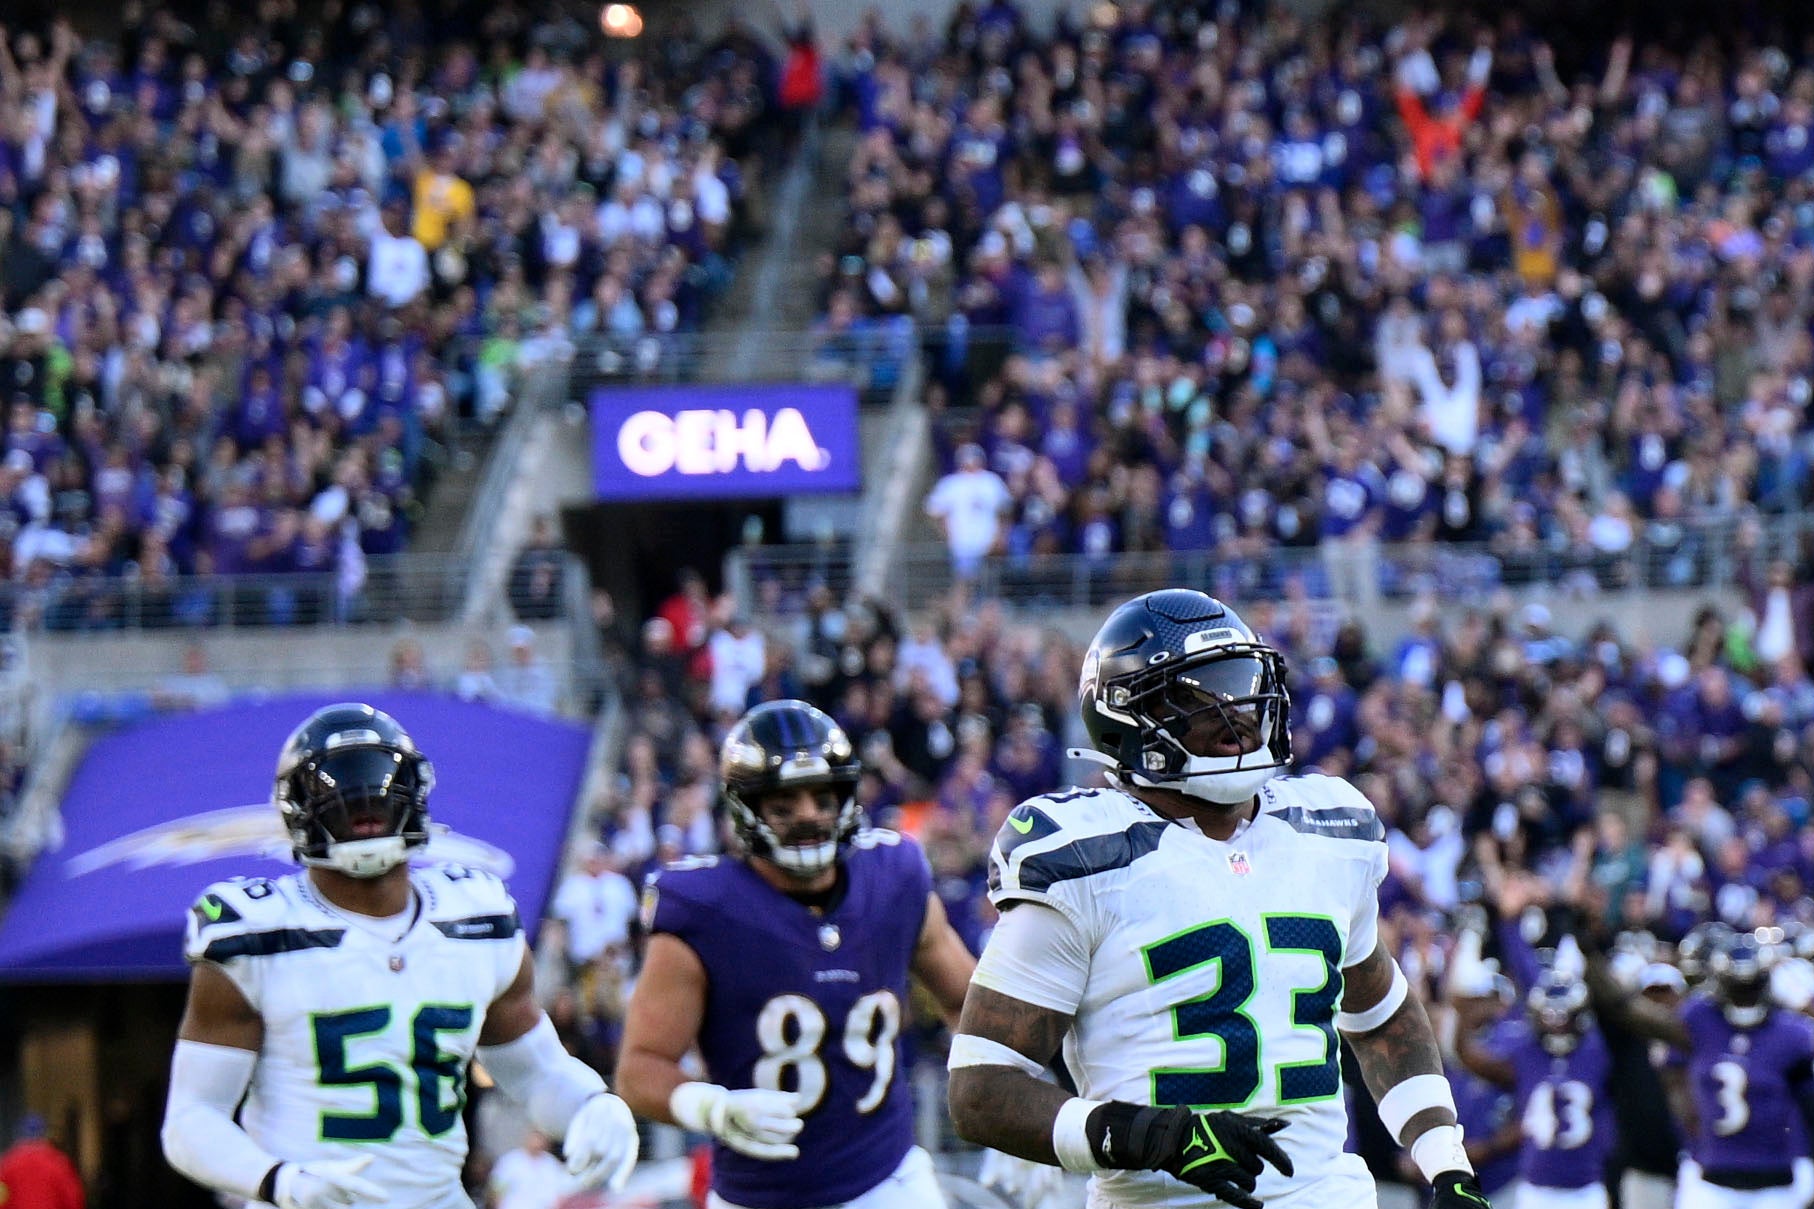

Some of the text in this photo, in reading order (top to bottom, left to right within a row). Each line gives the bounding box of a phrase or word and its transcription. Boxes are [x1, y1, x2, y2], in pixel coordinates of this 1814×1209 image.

[617, 408, 823, 477] GEHA
[753, 990, 901, 1117] 89
[1140, 912, 1345, 1109] 33
[308, 1001, 474, 1142] 56
[1522, 1080, 1593, 1150] 43
[1711, 1061, 1750, 1136] 3
